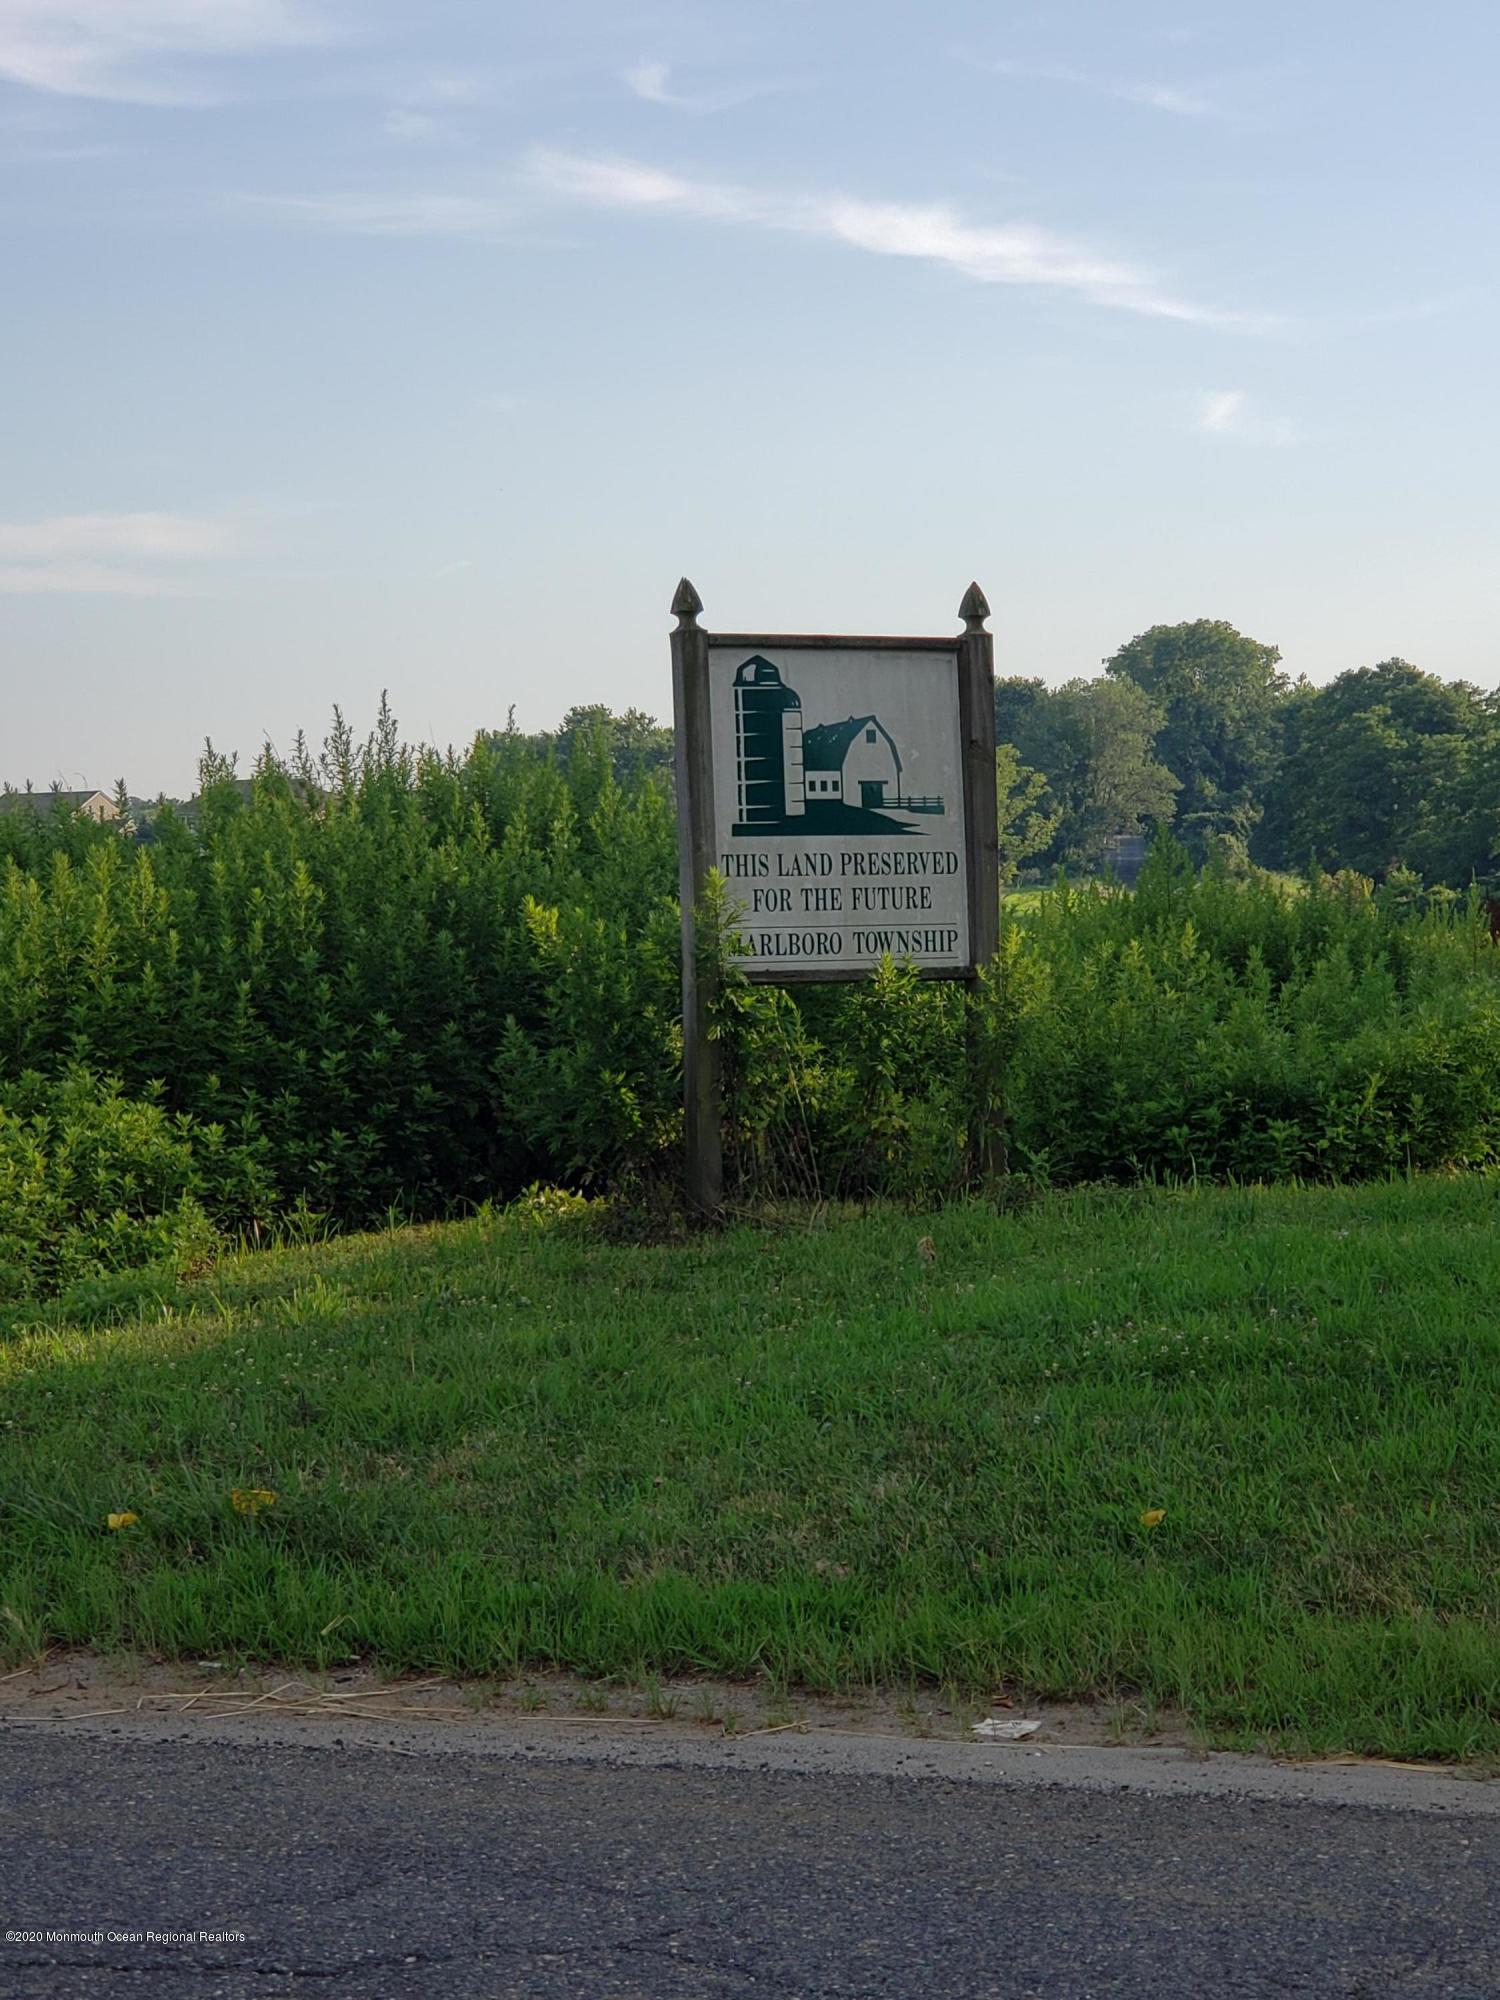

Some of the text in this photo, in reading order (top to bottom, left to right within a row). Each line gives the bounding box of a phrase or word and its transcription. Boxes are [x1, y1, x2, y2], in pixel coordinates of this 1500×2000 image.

[721, 851, 958, 878] THIS LAND PRESERVED
[753, 886, 932, 912] FOR THE FUTURE
[853, 929, 958, 953] TOWNSHIP
